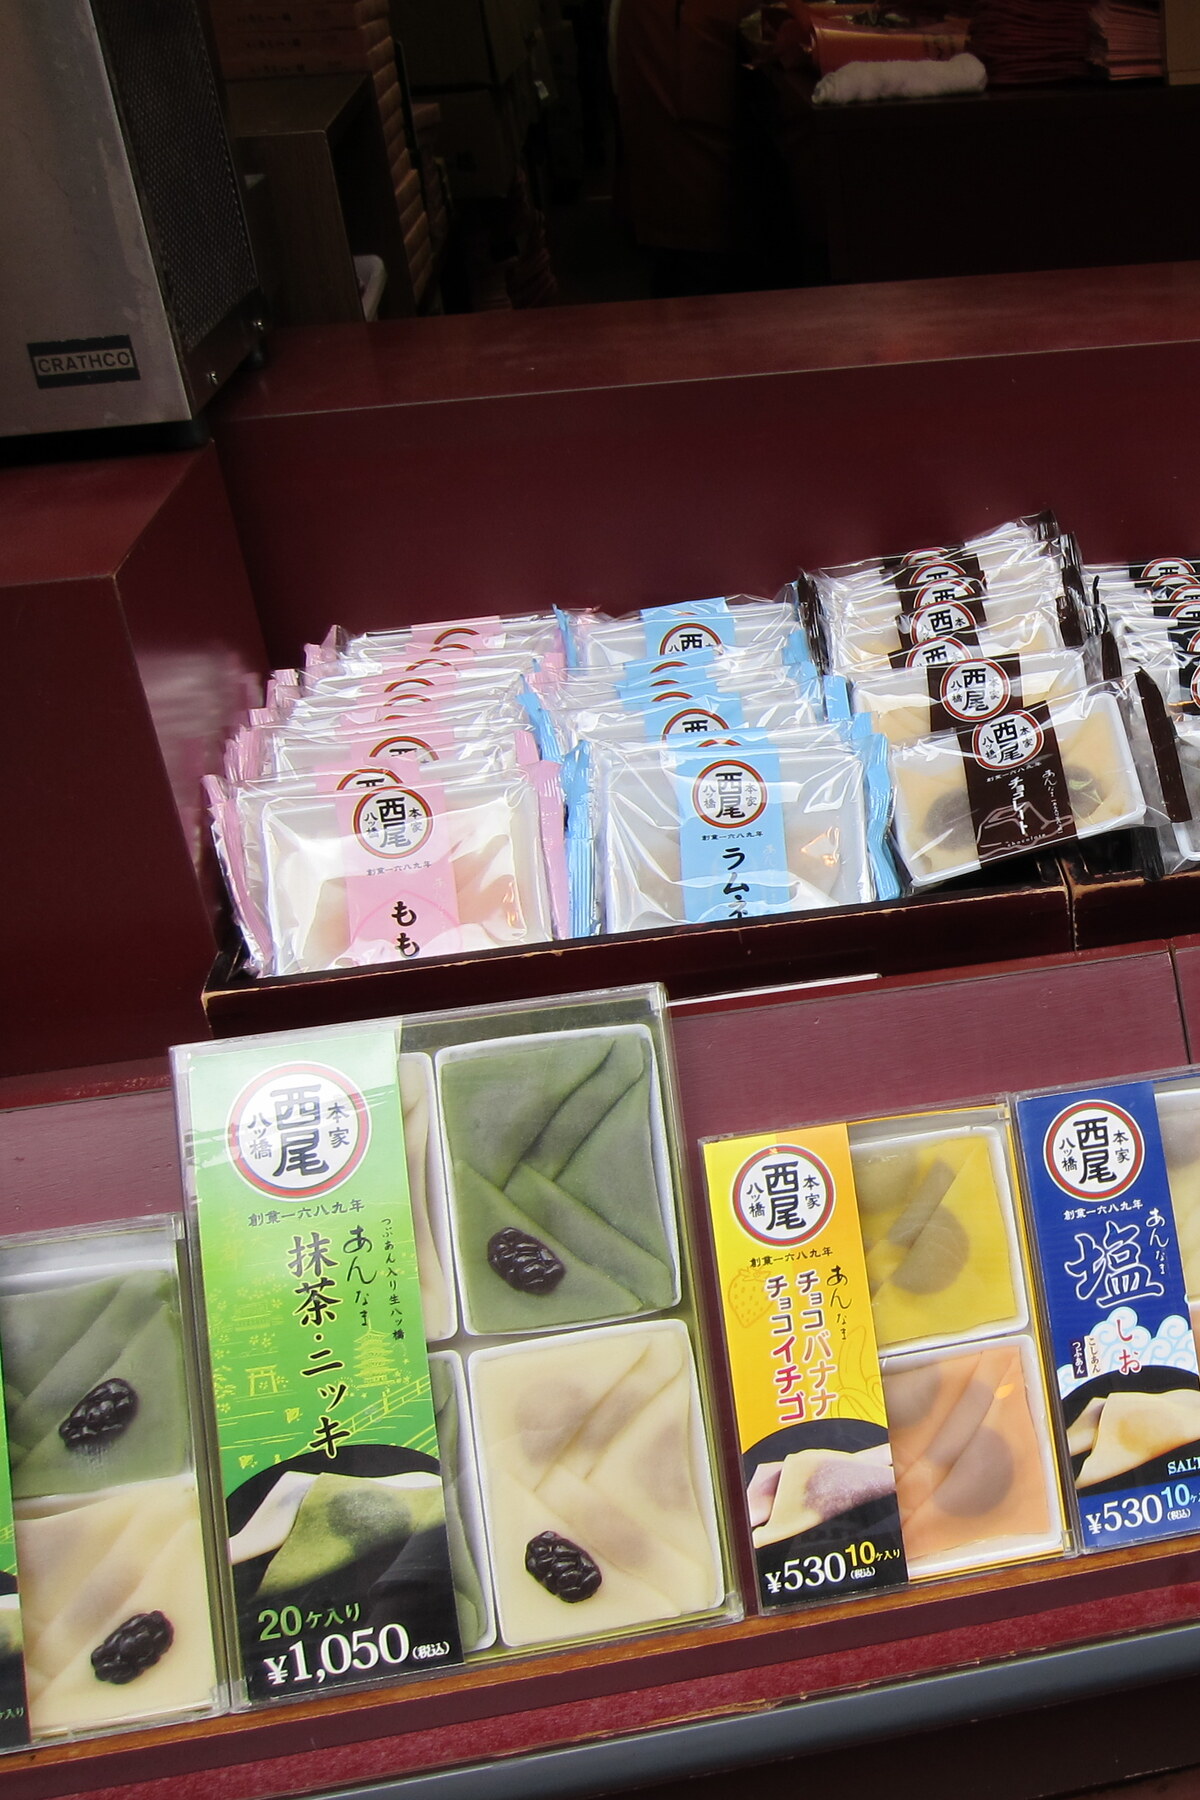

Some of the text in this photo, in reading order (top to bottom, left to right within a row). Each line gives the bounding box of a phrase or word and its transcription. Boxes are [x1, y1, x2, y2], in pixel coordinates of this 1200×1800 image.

[38, 351, 131, 373] CRATHCO
[961, 667, 990, 712] 西尾
[992, 718, 1024, 765] 西尾
[715, 771, 746, 819] 西尾
[376, 796, 412, 849] 西尾
[722, 847, 750, 919] ラムネ
[391, 900, 420, 960] もも
[269, 1083, 330, 1178] 西尾
[327, 1102, 350, 1149] 本家
[1072, 1116, 1117, 1185] 西尾
[1112, 1129, 1131, 1164] 本家
[247, 1198, 366, 1227] 創業一六八九年
[761, 1160, 807, 1231] 西尾
[802, 1174, 821, 1210] 本家
[1062, 1199, 1144, 1221] 創業一六八九年
[749, 1246, 834, 1269] 創業一六八九年
[1064, 1220, 1165, 1309] 塩
[1145, 1207, 1170, 1275] あんなま
[342, 1224, 378, 1328] あんなま
[826, 1264, 852, 1341] あんなま
[286, 1231, 351, 1459] 抹茶・ニッキ
[765, 1274, 805, 1424] チョコイチゴ
[797, 1269, 838, 1418] チョコバナナ
[1072, 1341, 1086, 1375] つぶあん
[1087, 1337, 1101, 1374] こしあん
[1115, 1318, 1143, 1376] しお
[1085, 1493, 1164, 1535] ¥530
[764, 1553, 847, 1595] ¥530
[263, 1623, 410, 1686] ¥1,050
